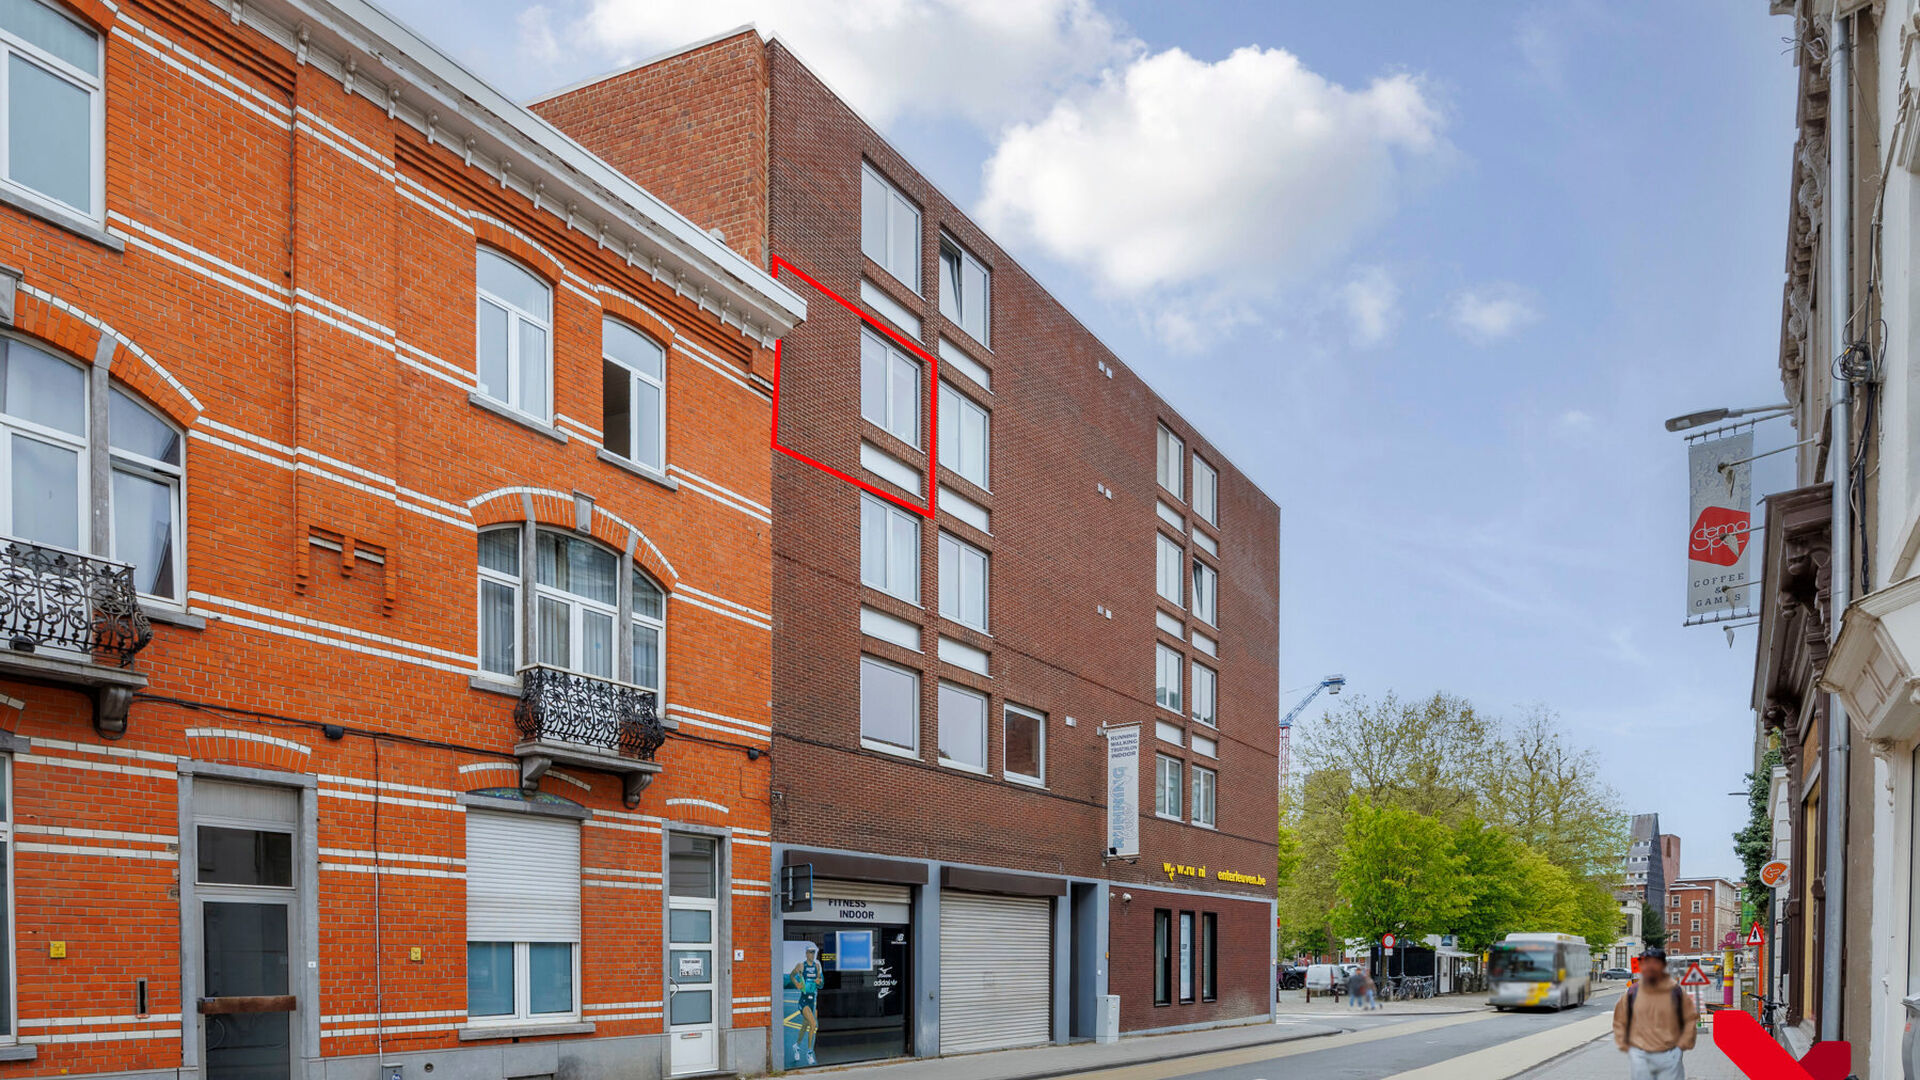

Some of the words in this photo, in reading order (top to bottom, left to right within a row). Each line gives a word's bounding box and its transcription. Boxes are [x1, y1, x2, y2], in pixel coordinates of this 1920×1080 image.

[1694, 521, 1748, 540] demo
[1694, 573, 1745, 588] COFFEE
[1110, 733, 1138, 741] RUNNING
[1110, 739, 1138, 747] WALKING
[828, 899, 866, 908] FITNESS
[840, 910, 874, 919] INDOOR
